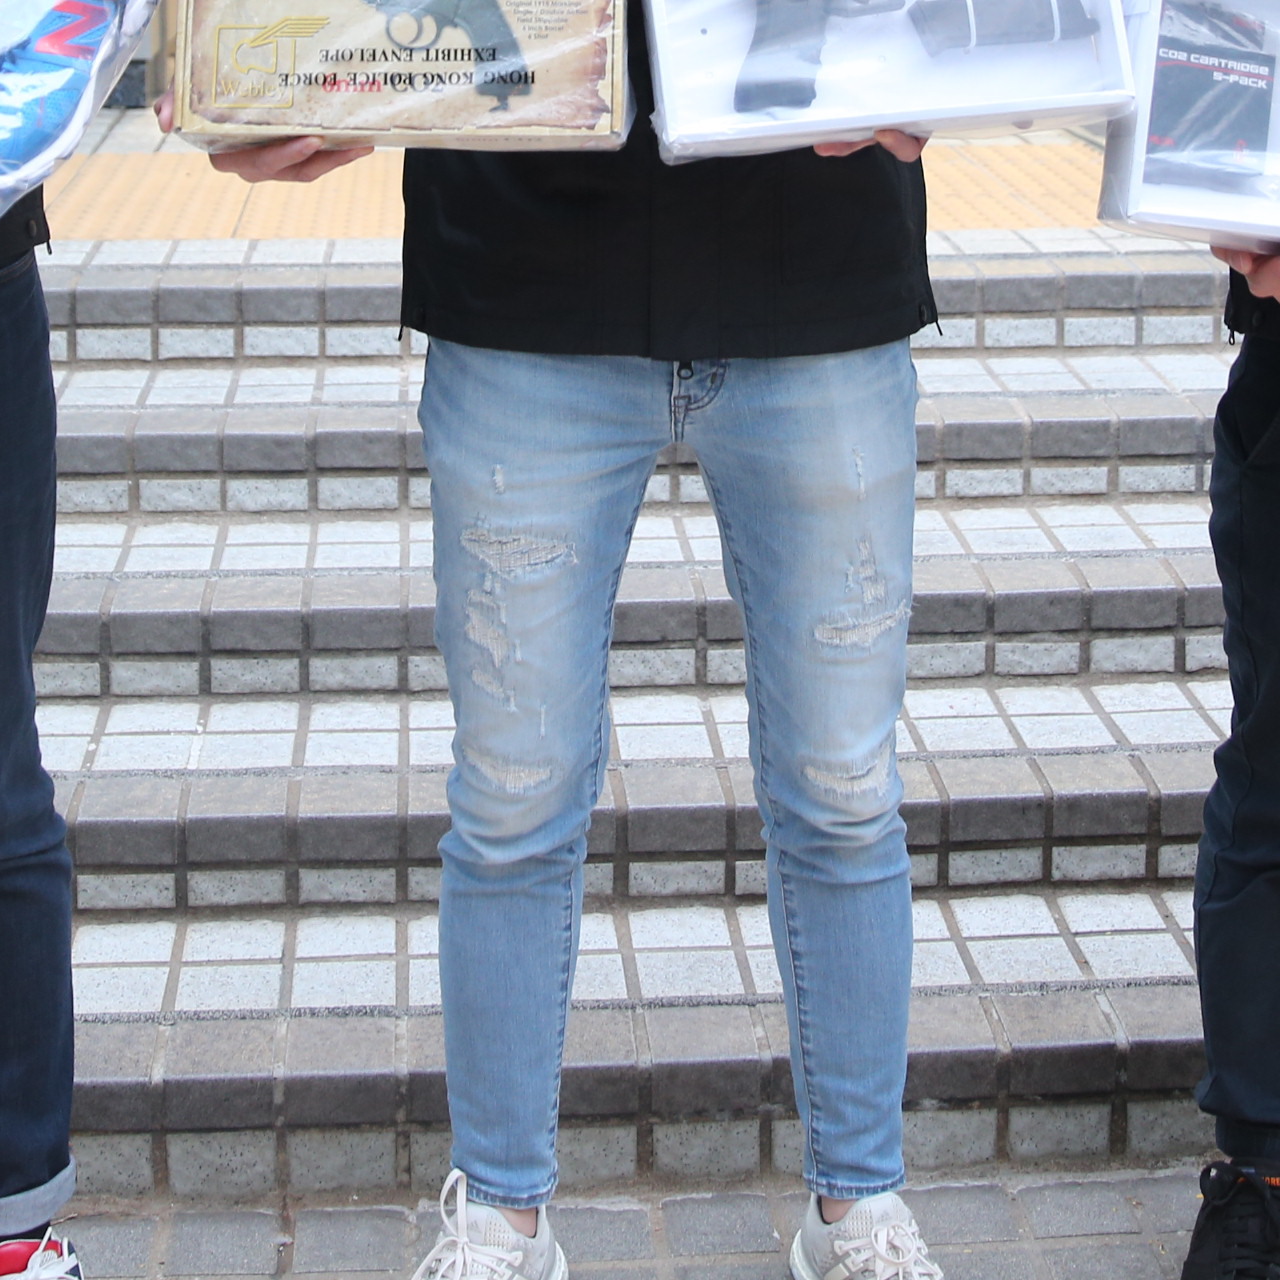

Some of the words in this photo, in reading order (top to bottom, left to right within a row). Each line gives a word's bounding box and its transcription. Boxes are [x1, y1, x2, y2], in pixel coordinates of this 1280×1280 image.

[319, 48, 414, 63] ENVELOPE
[421, 48, 497, 62] EXHIBIT
[279, 72, 337, 87] FORCE
[350, 71, 413, 85] POLICE
[423, 70, 474, 85] KONG
[483, 70, 536, 85] HONG
[221, 78, 287, 99] Webley
